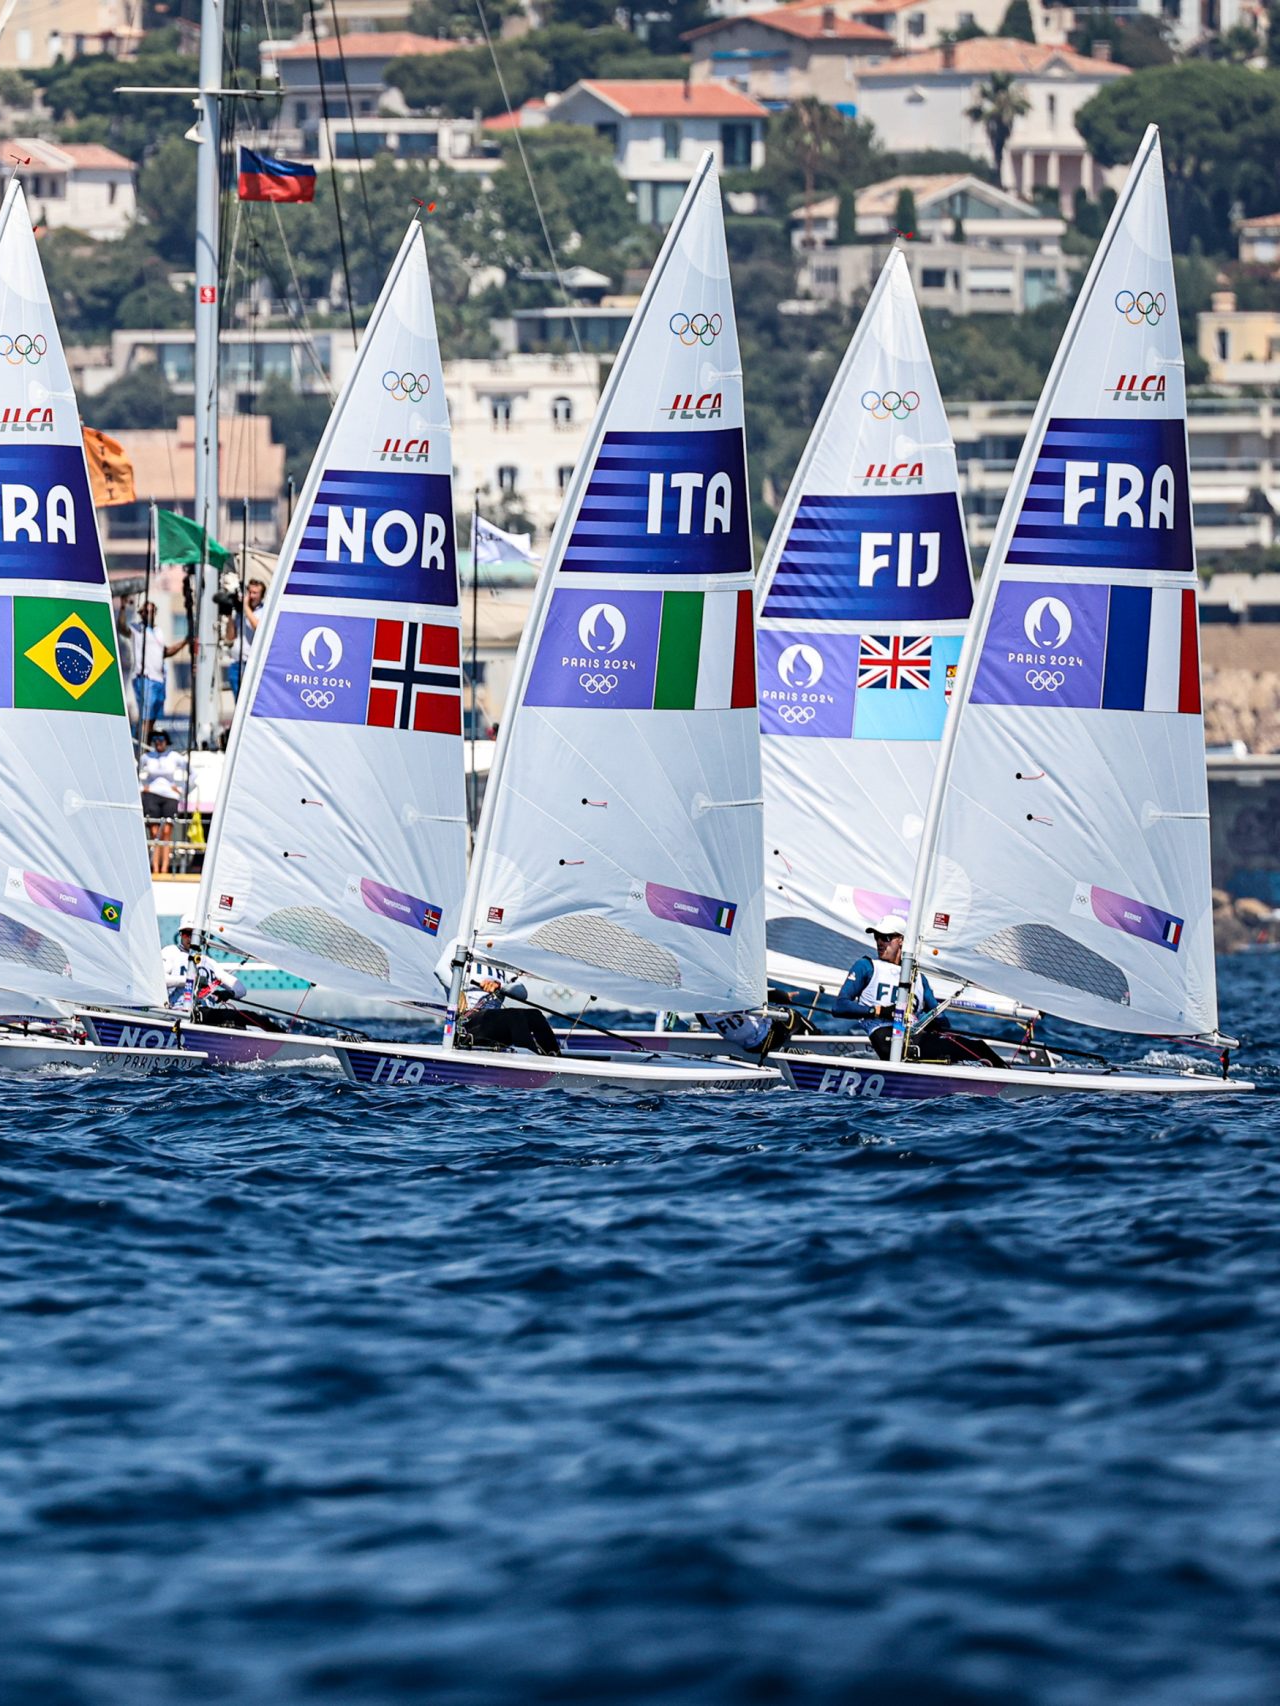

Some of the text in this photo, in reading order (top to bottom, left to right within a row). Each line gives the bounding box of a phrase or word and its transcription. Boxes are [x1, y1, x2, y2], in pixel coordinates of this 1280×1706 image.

[1113, 375, 1166, 401] ILCA
[669, 393, 722, 420] ILCA
[0, 408, 54, 433] ILCA
[380, 439, 429, 462] ILCA
[863, 463, 924, 486] ILCA
[646, 471, 732, 534] ITA
[1063, 460, 1175, 530] FRA
[326, 505, 446, 570] NOR
[858, 532, 940, 587] FIJ
[562, 657, 636, 670] PARIS 2024
[1008, 653, 1083, 667] PARIS 2024
[286, 674, 351, 688] PARIS 2024
[763, 691, 833, 704] PARIS 2024
[371, 1057, 425, 1085] ITA
[818, 1068, 885, 1097] FRA
